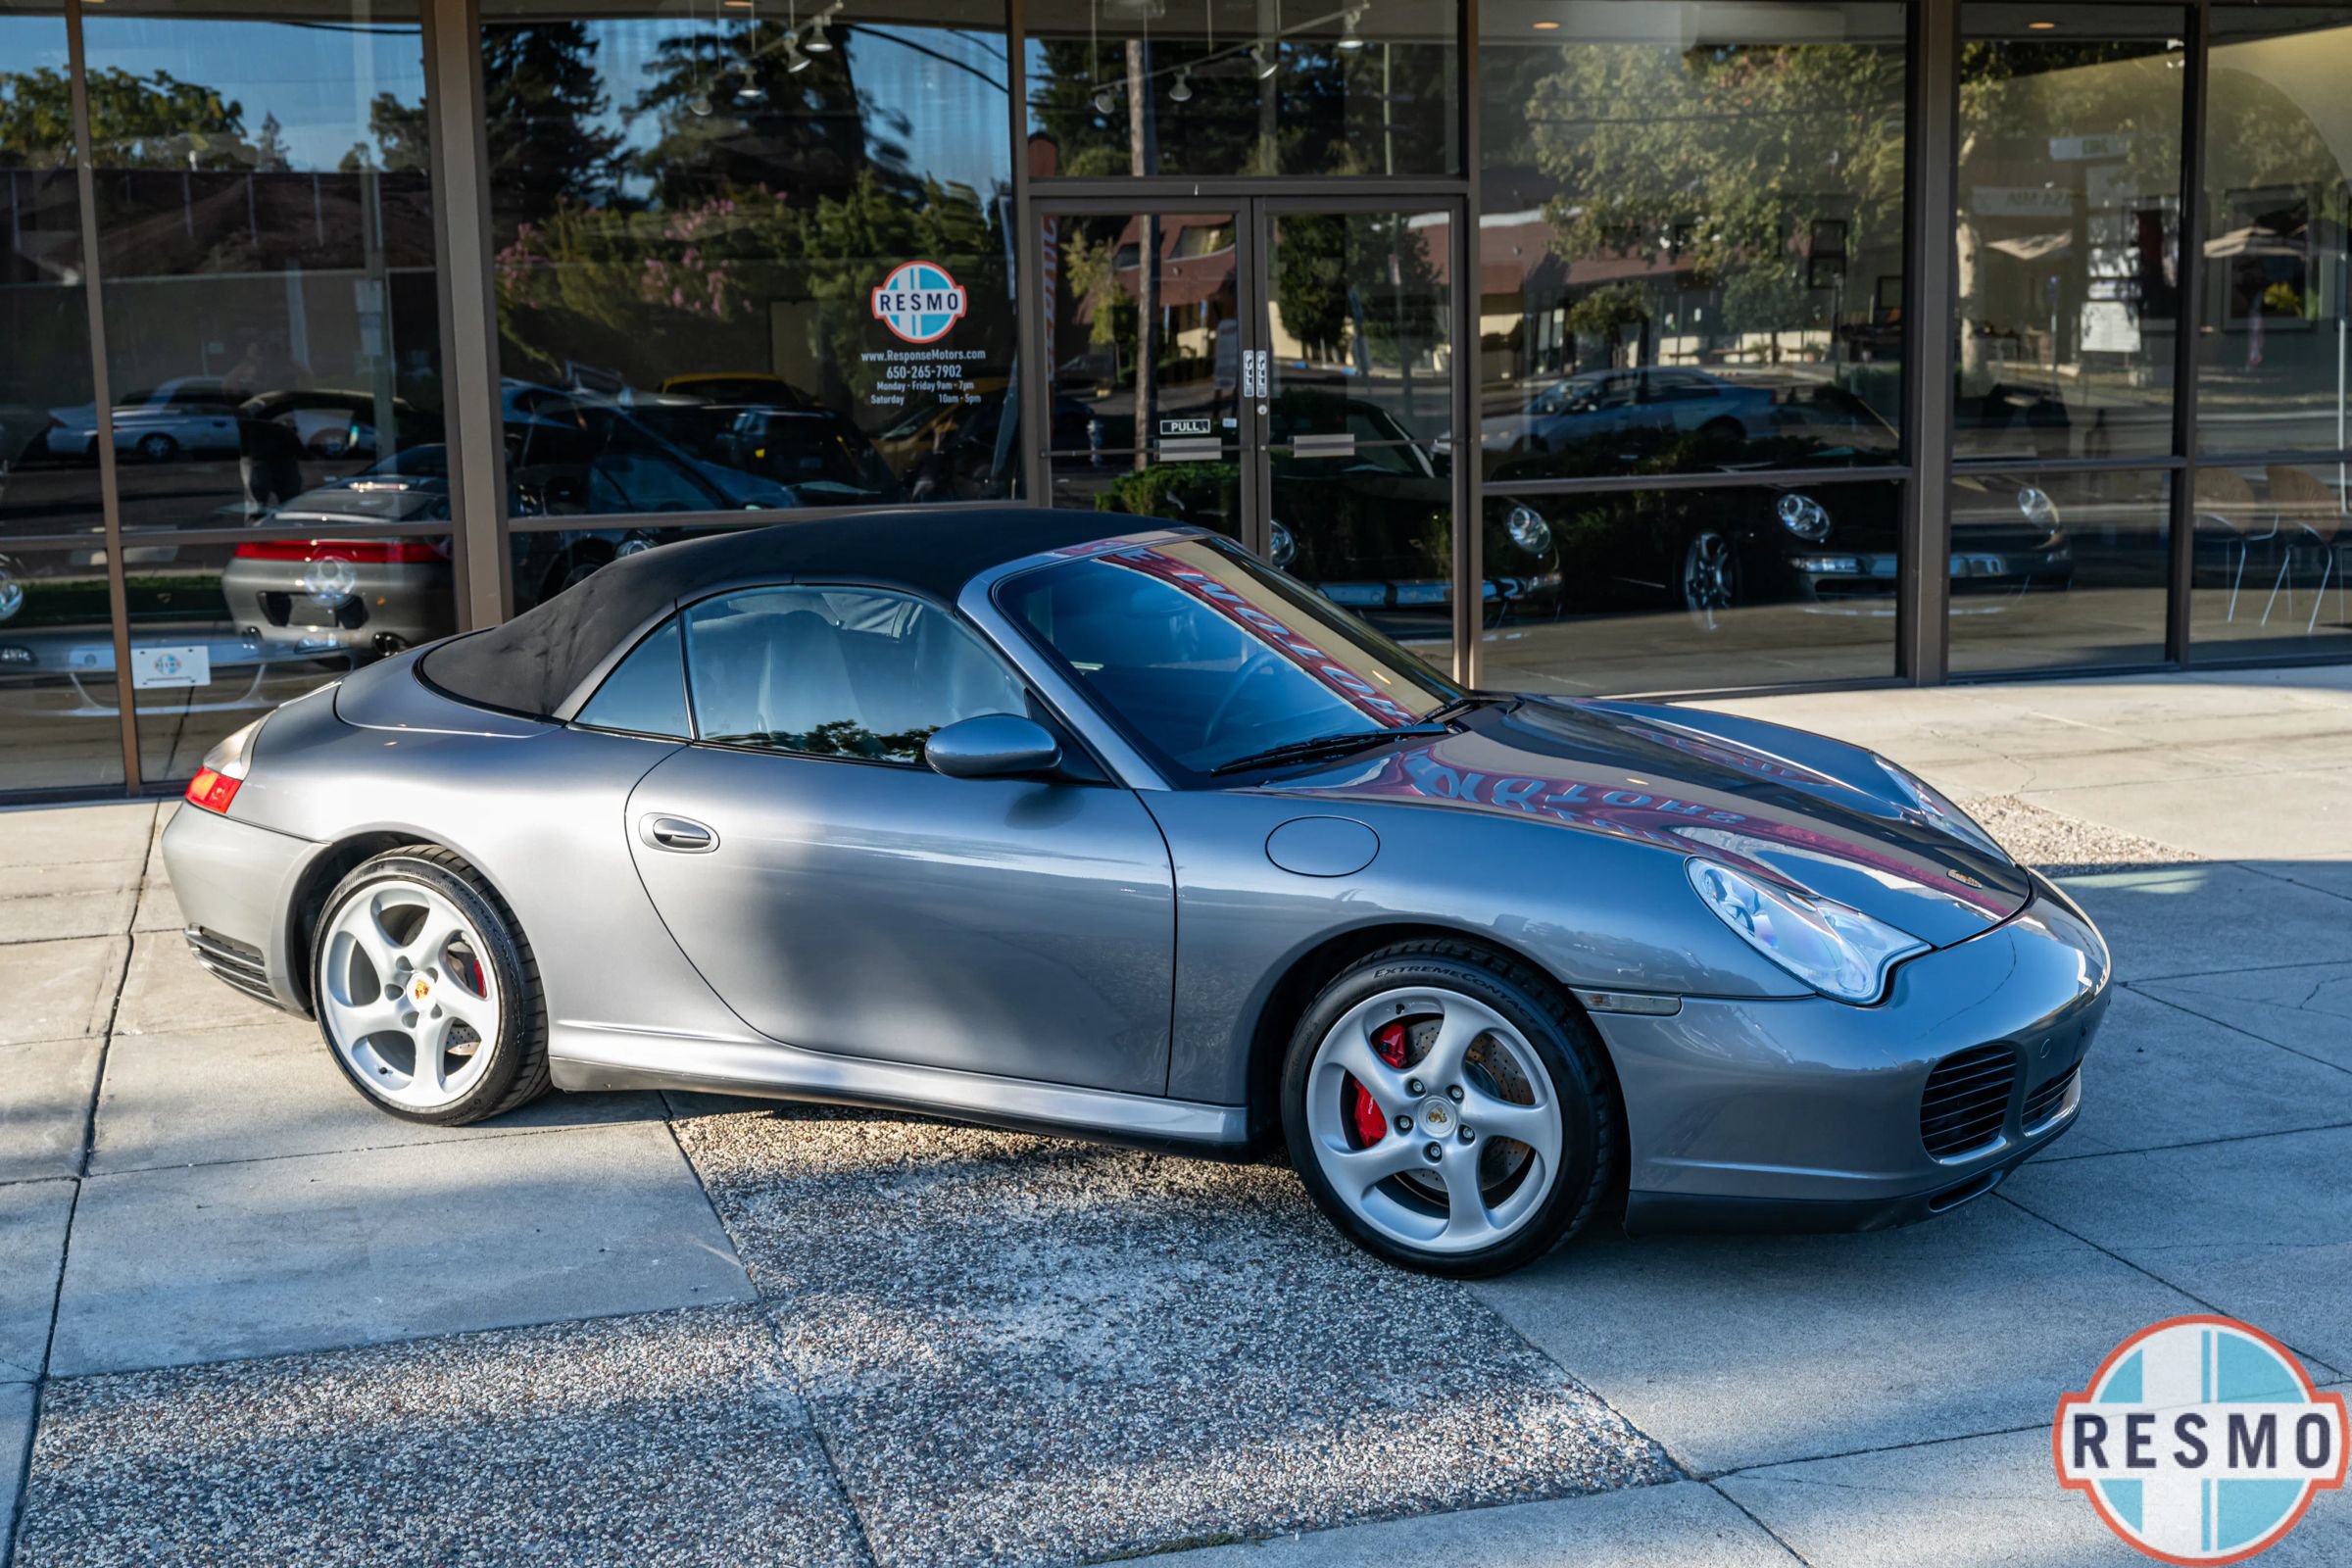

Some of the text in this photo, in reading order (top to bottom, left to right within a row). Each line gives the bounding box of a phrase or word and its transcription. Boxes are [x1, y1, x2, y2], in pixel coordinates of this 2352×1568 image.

[880, 293, 958, 312] RESMO
[861, 349, 986, 364] www.ResponseMotors.com
[886, 365, 962, 379] 650-265-7902
[876, 381, 906, 392] Monday
[911, 380, 935, 392] Friday
[936, 381, 953, 390] 9am
[870, 394, 905, 406] Saturday
[939, 394, 958, 404] 10am
[1171, 421, 1200, 432] PULL
